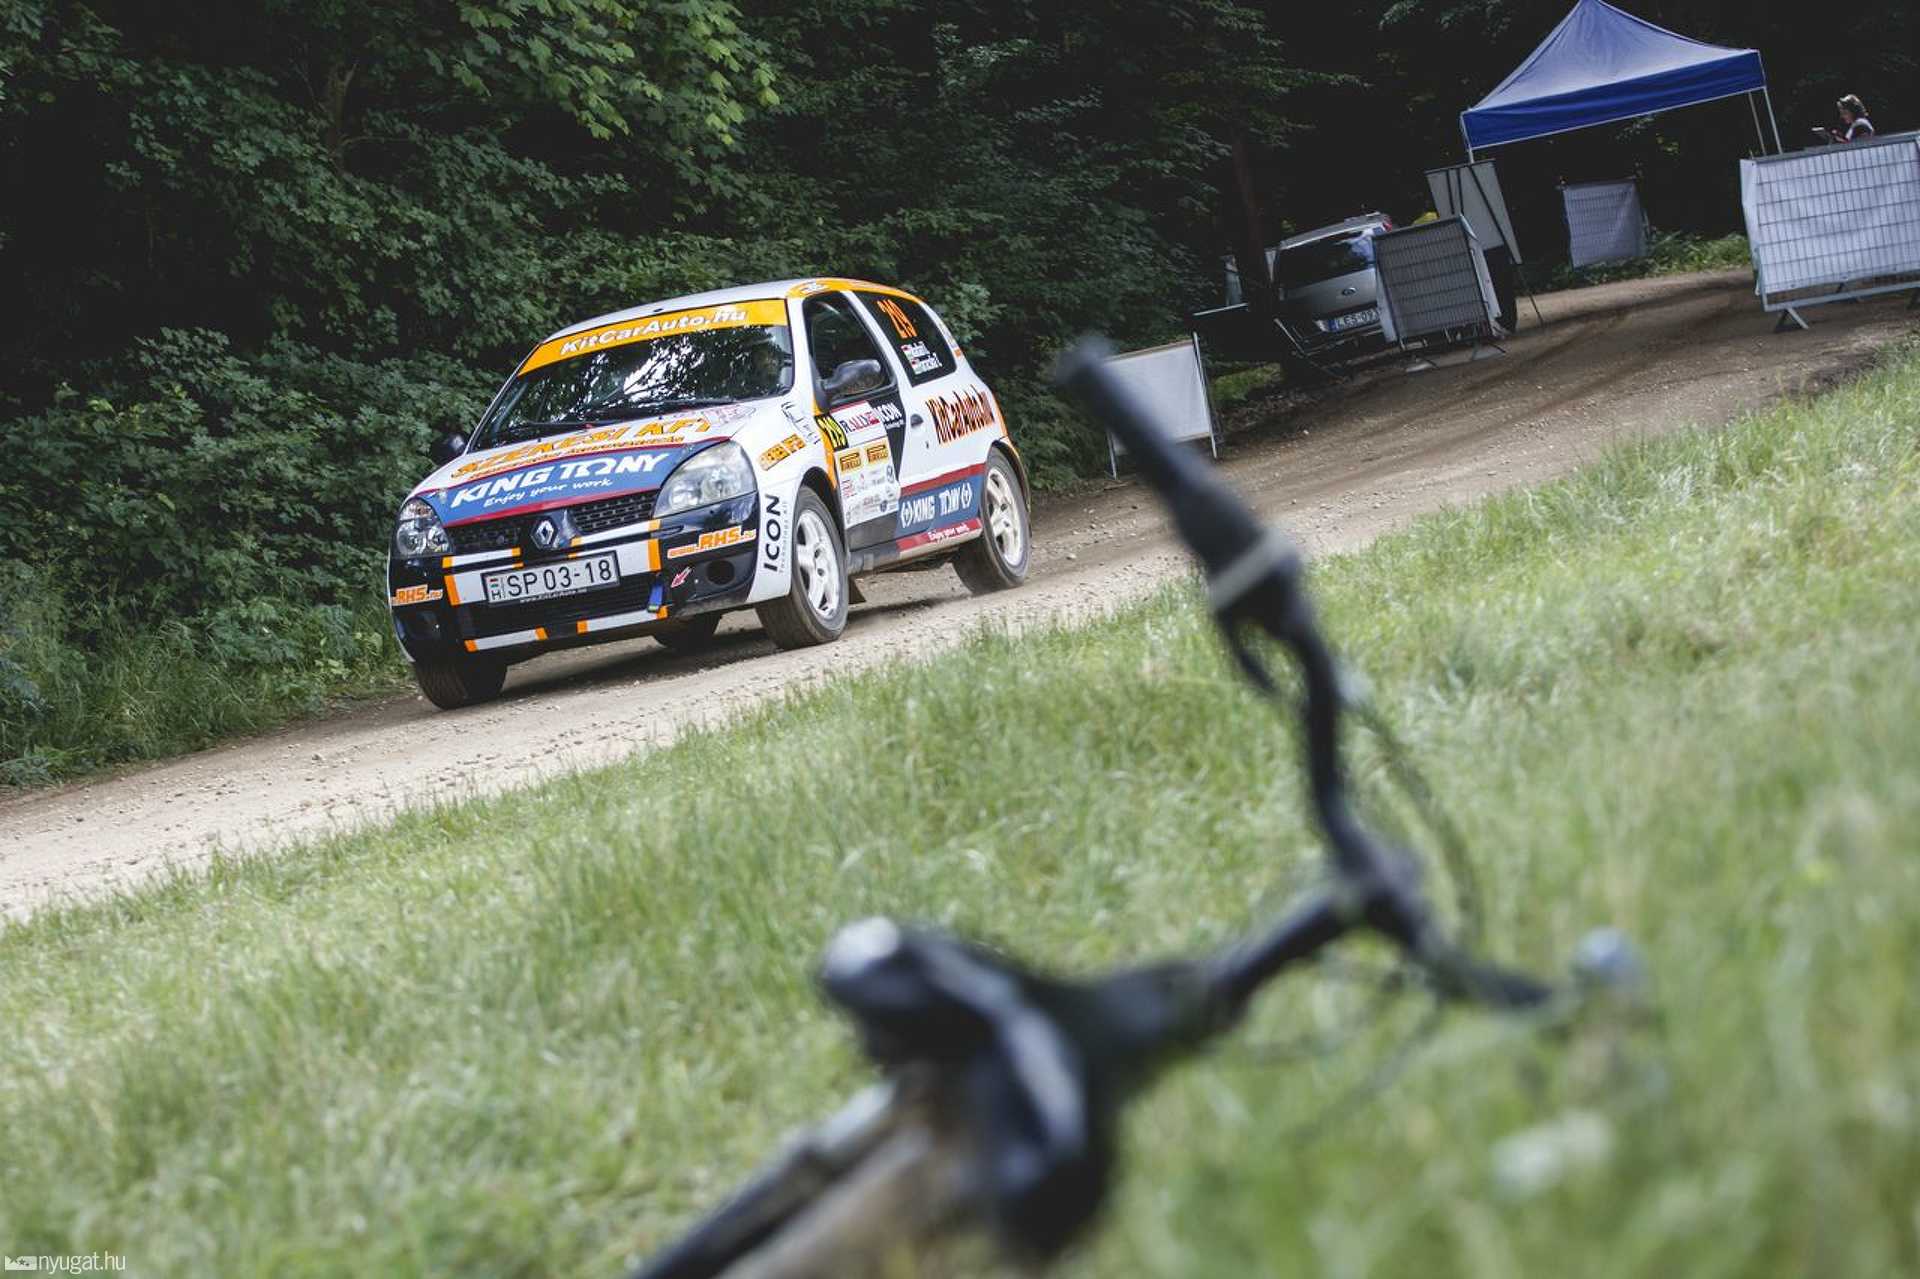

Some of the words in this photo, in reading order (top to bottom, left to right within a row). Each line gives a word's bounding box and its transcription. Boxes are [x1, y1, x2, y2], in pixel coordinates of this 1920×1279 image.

[560, 309, 747, 356] KitCarAuto.hu
[451, 468, 553, 508] KING
[483, 491, 526, 508] Enjoy
[530, 483, 567, 499] your
[572, 476, 614, 490] work
[912, 496, 936, 524] KING
[763, 494, 782, 573] ICON
